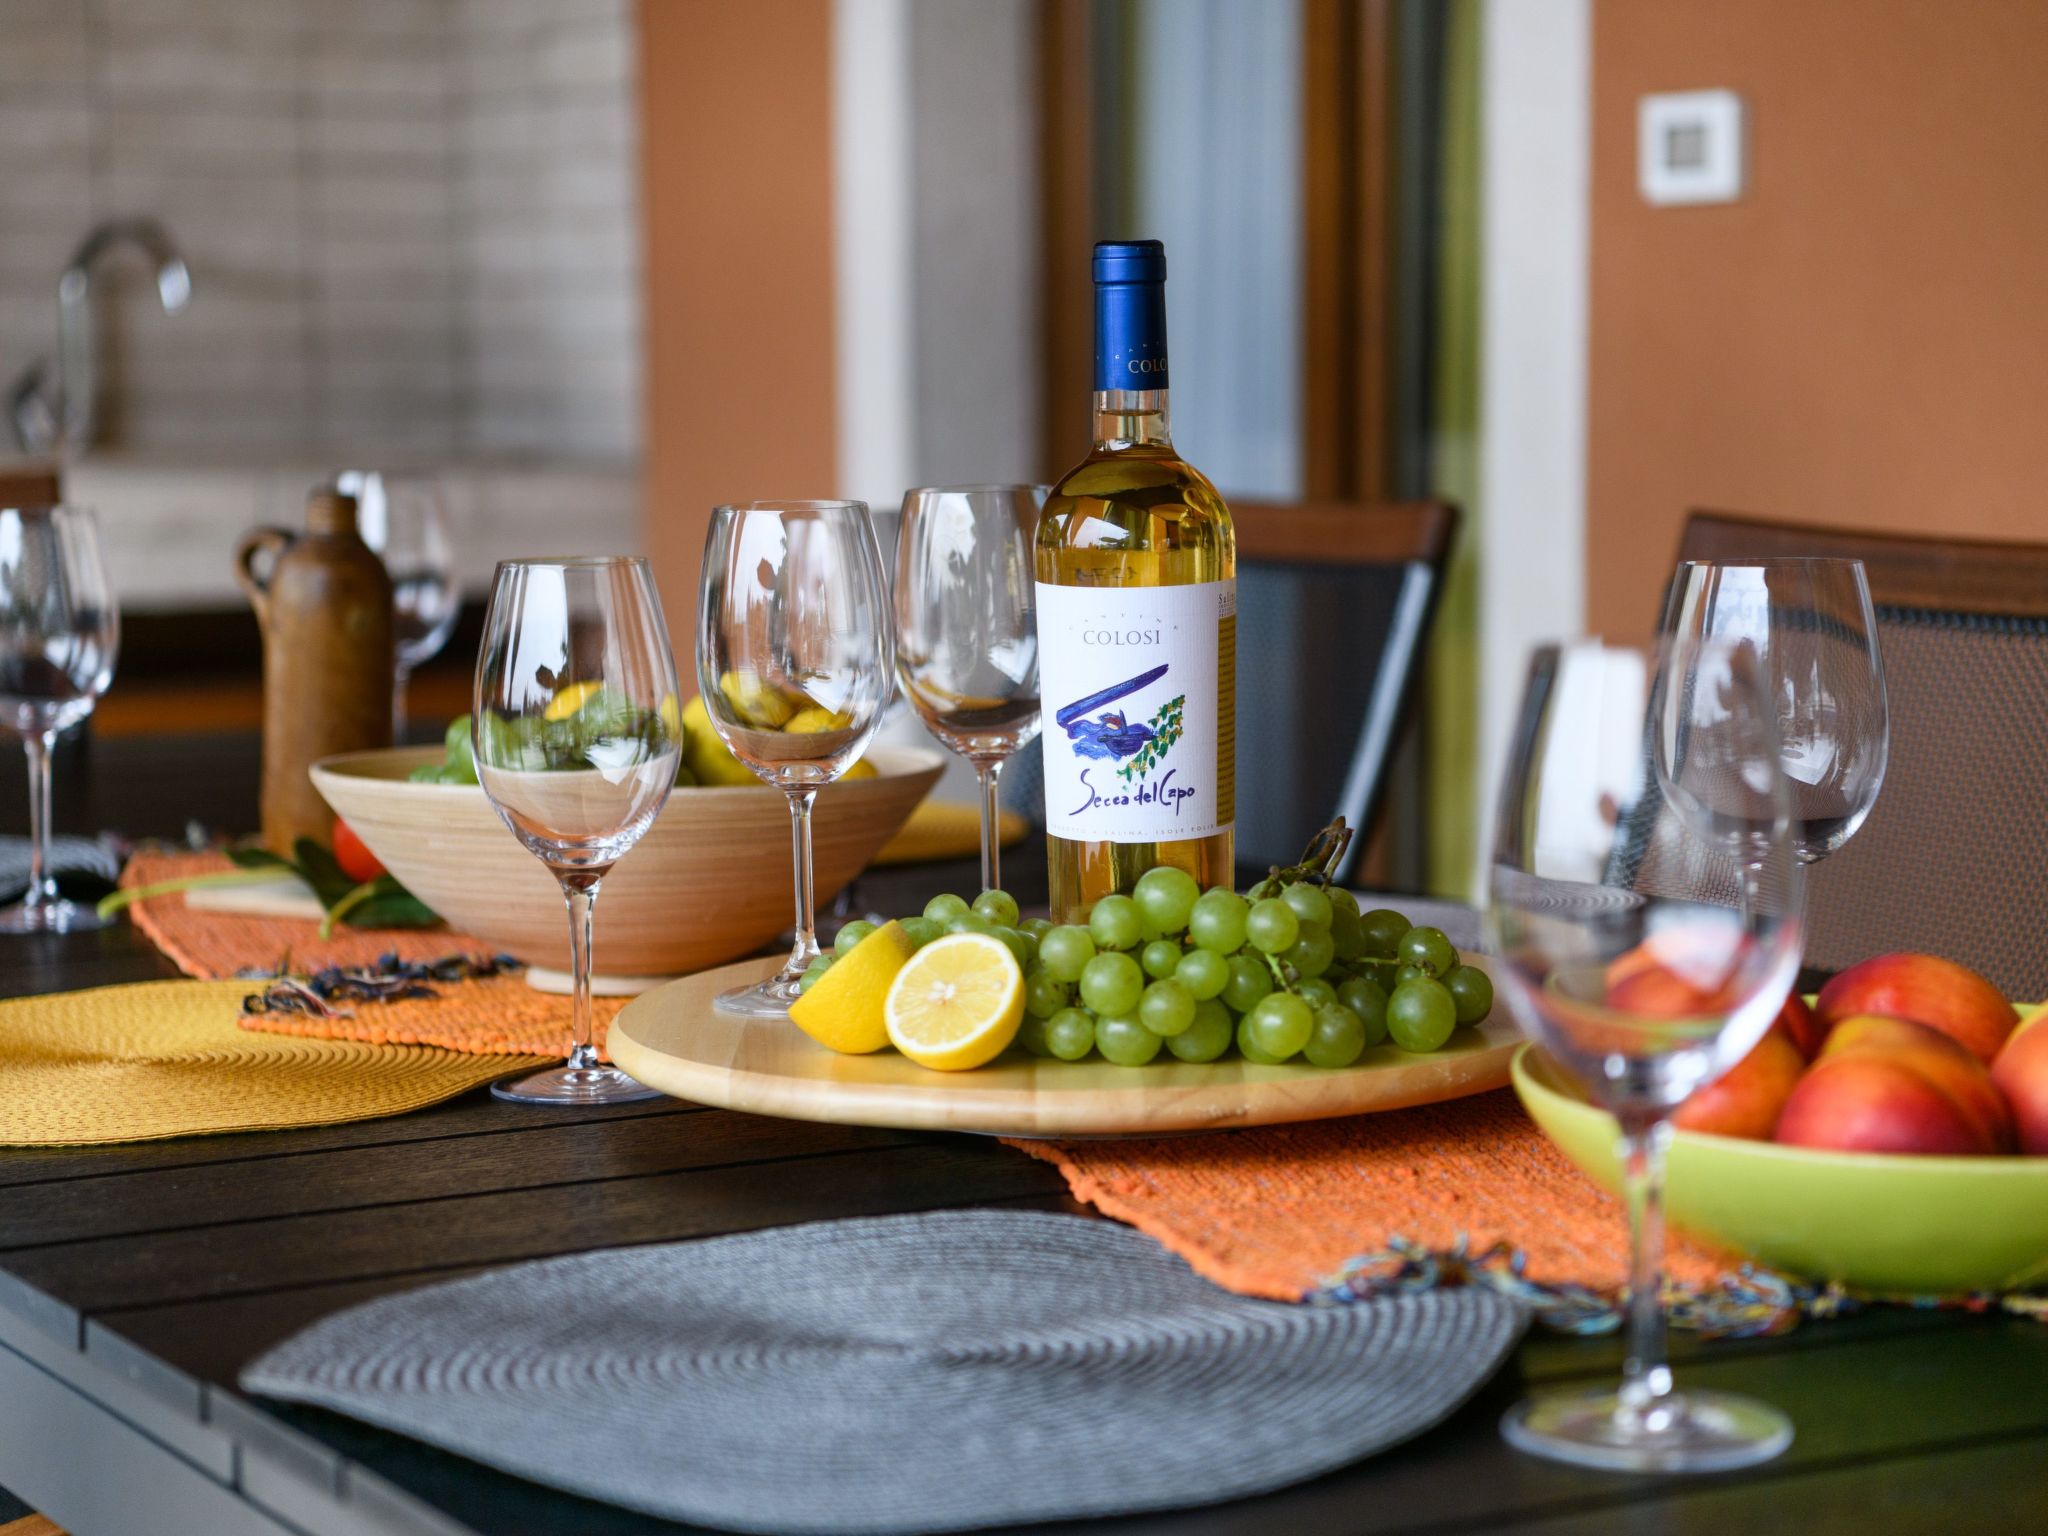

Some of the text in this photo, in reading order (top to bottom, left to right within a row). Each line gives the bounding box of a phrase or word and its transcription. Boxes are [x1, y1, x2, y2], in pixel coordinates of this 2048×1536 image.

[1083, 629, 1161, 646] COLOSI
[1068, 767, 1196, 817] Secca del Capo
